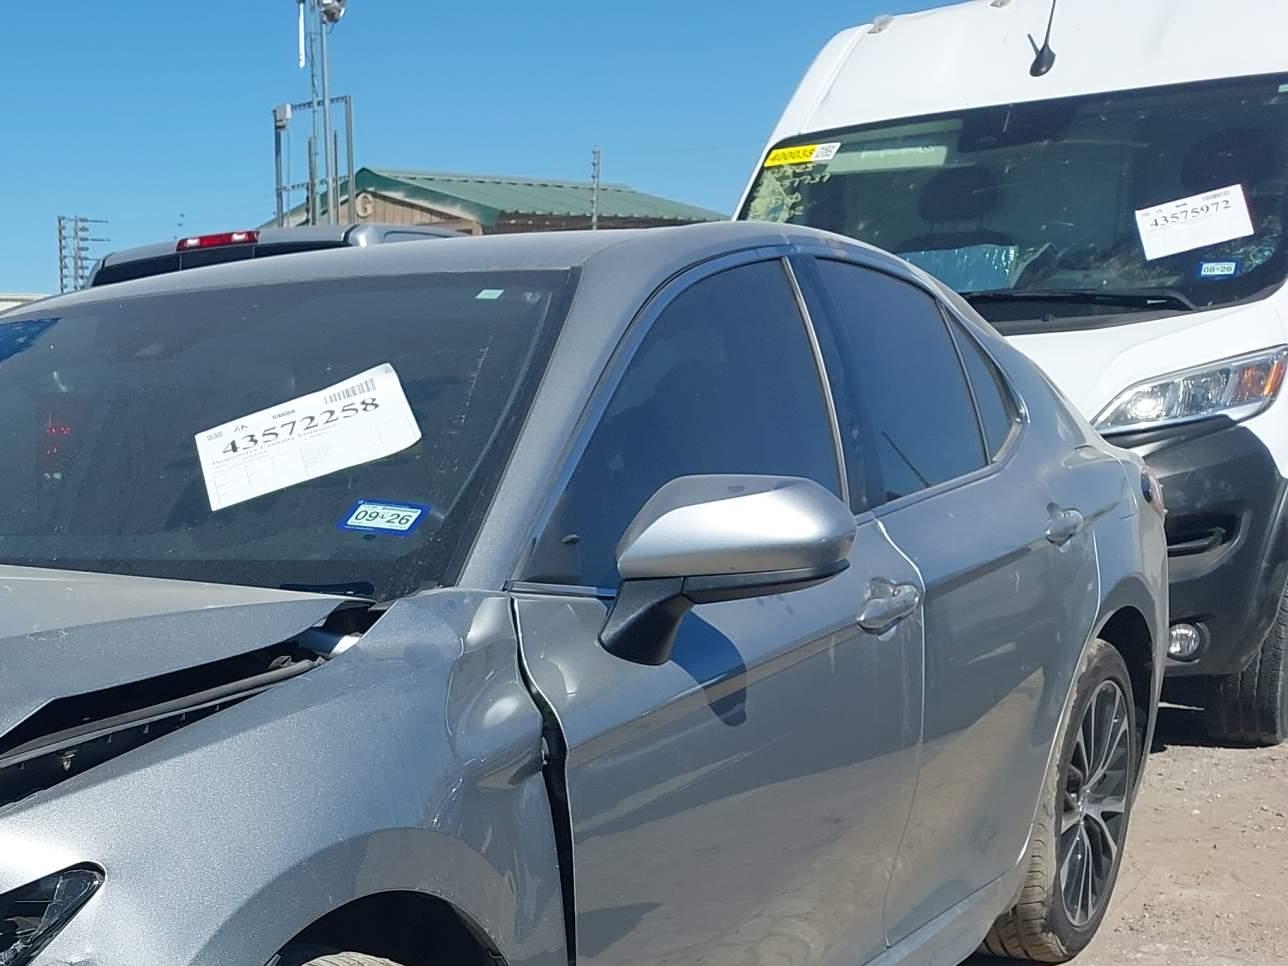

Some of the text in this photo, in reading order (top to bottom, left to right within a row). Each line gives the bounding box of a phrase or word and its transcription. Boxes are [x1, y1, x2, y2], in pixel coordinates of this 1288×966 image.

[356, 192, 373, 217] G
[1150, 199, 1232, 227] 43575972
[222, 397, 380, 454] 43572258
